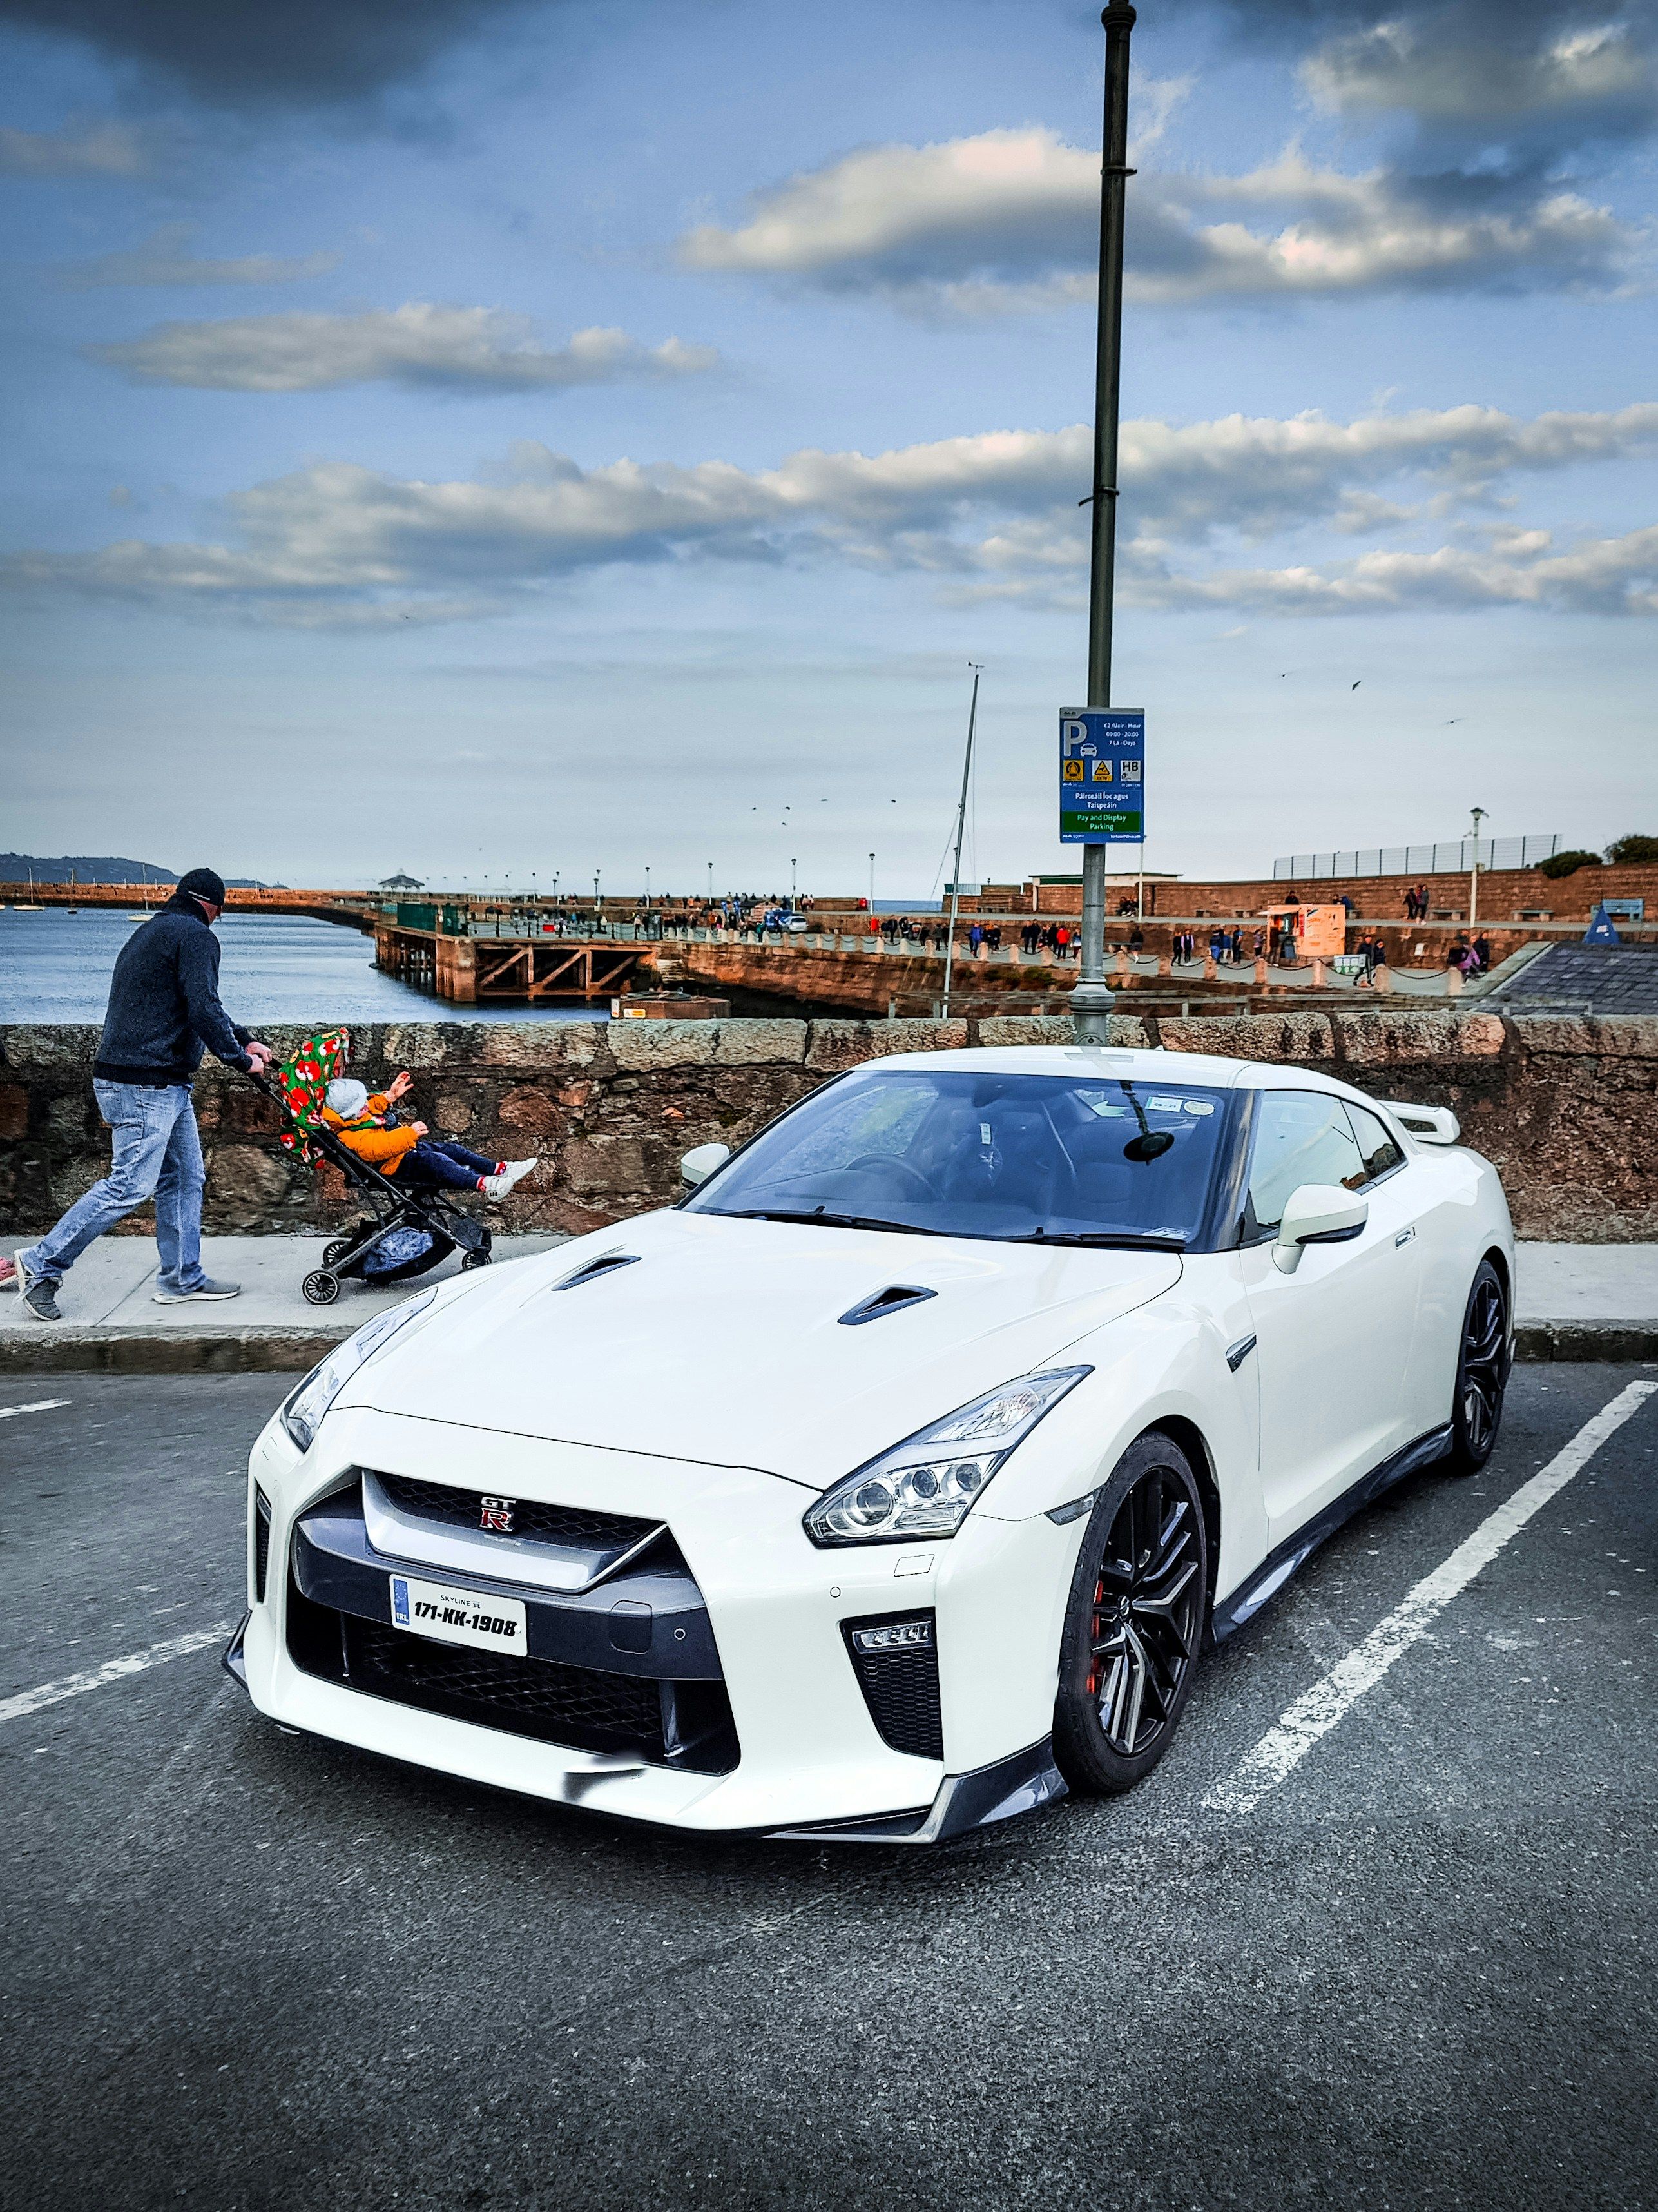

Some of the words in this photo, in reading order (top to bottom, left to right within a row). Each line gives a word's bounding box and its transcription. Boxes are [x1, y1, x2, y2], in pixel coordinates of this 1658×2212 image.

[1063, 720, 1087, 756] P
[1123, 761, 1139, 771] HB
[1077, 814, 1089, 822] Pay
[1103, 814, 1126, 822] Display
[1090, 823, 1114, 831] Parking
[481, 1497, 516, 1509] GT
[479, 1508, 512, 1531] R
[440, 1595, 470, 1606] SKYLINE
[396, 1613, 409, 1622] IRL
[414, 1602, 517, 1636] 171-KK-1908
